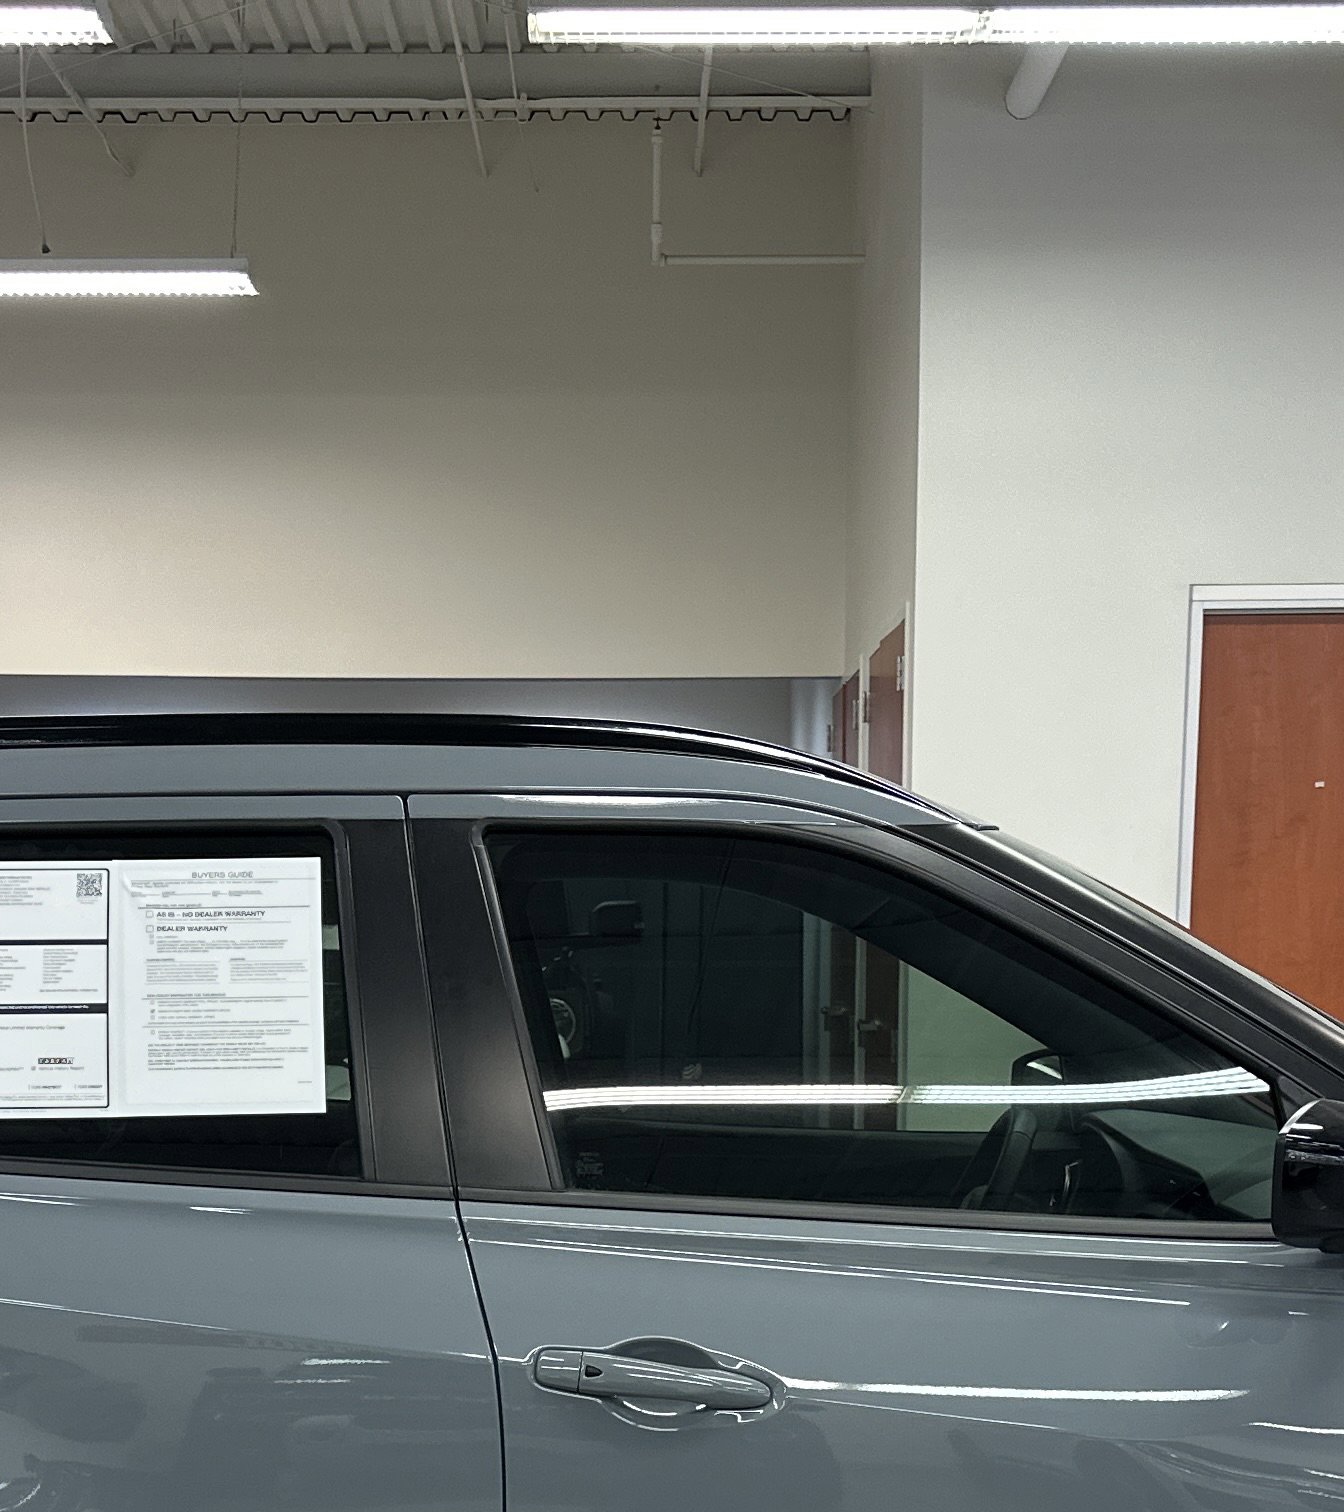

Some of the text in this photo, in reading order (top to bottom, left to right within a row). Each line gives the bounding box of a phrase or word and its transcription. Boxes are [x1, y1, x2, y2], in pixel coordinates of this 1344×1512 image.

[191, 870, 253, 879] BUYERS GUIDE
[194, 910, 223, 918] DEALER
